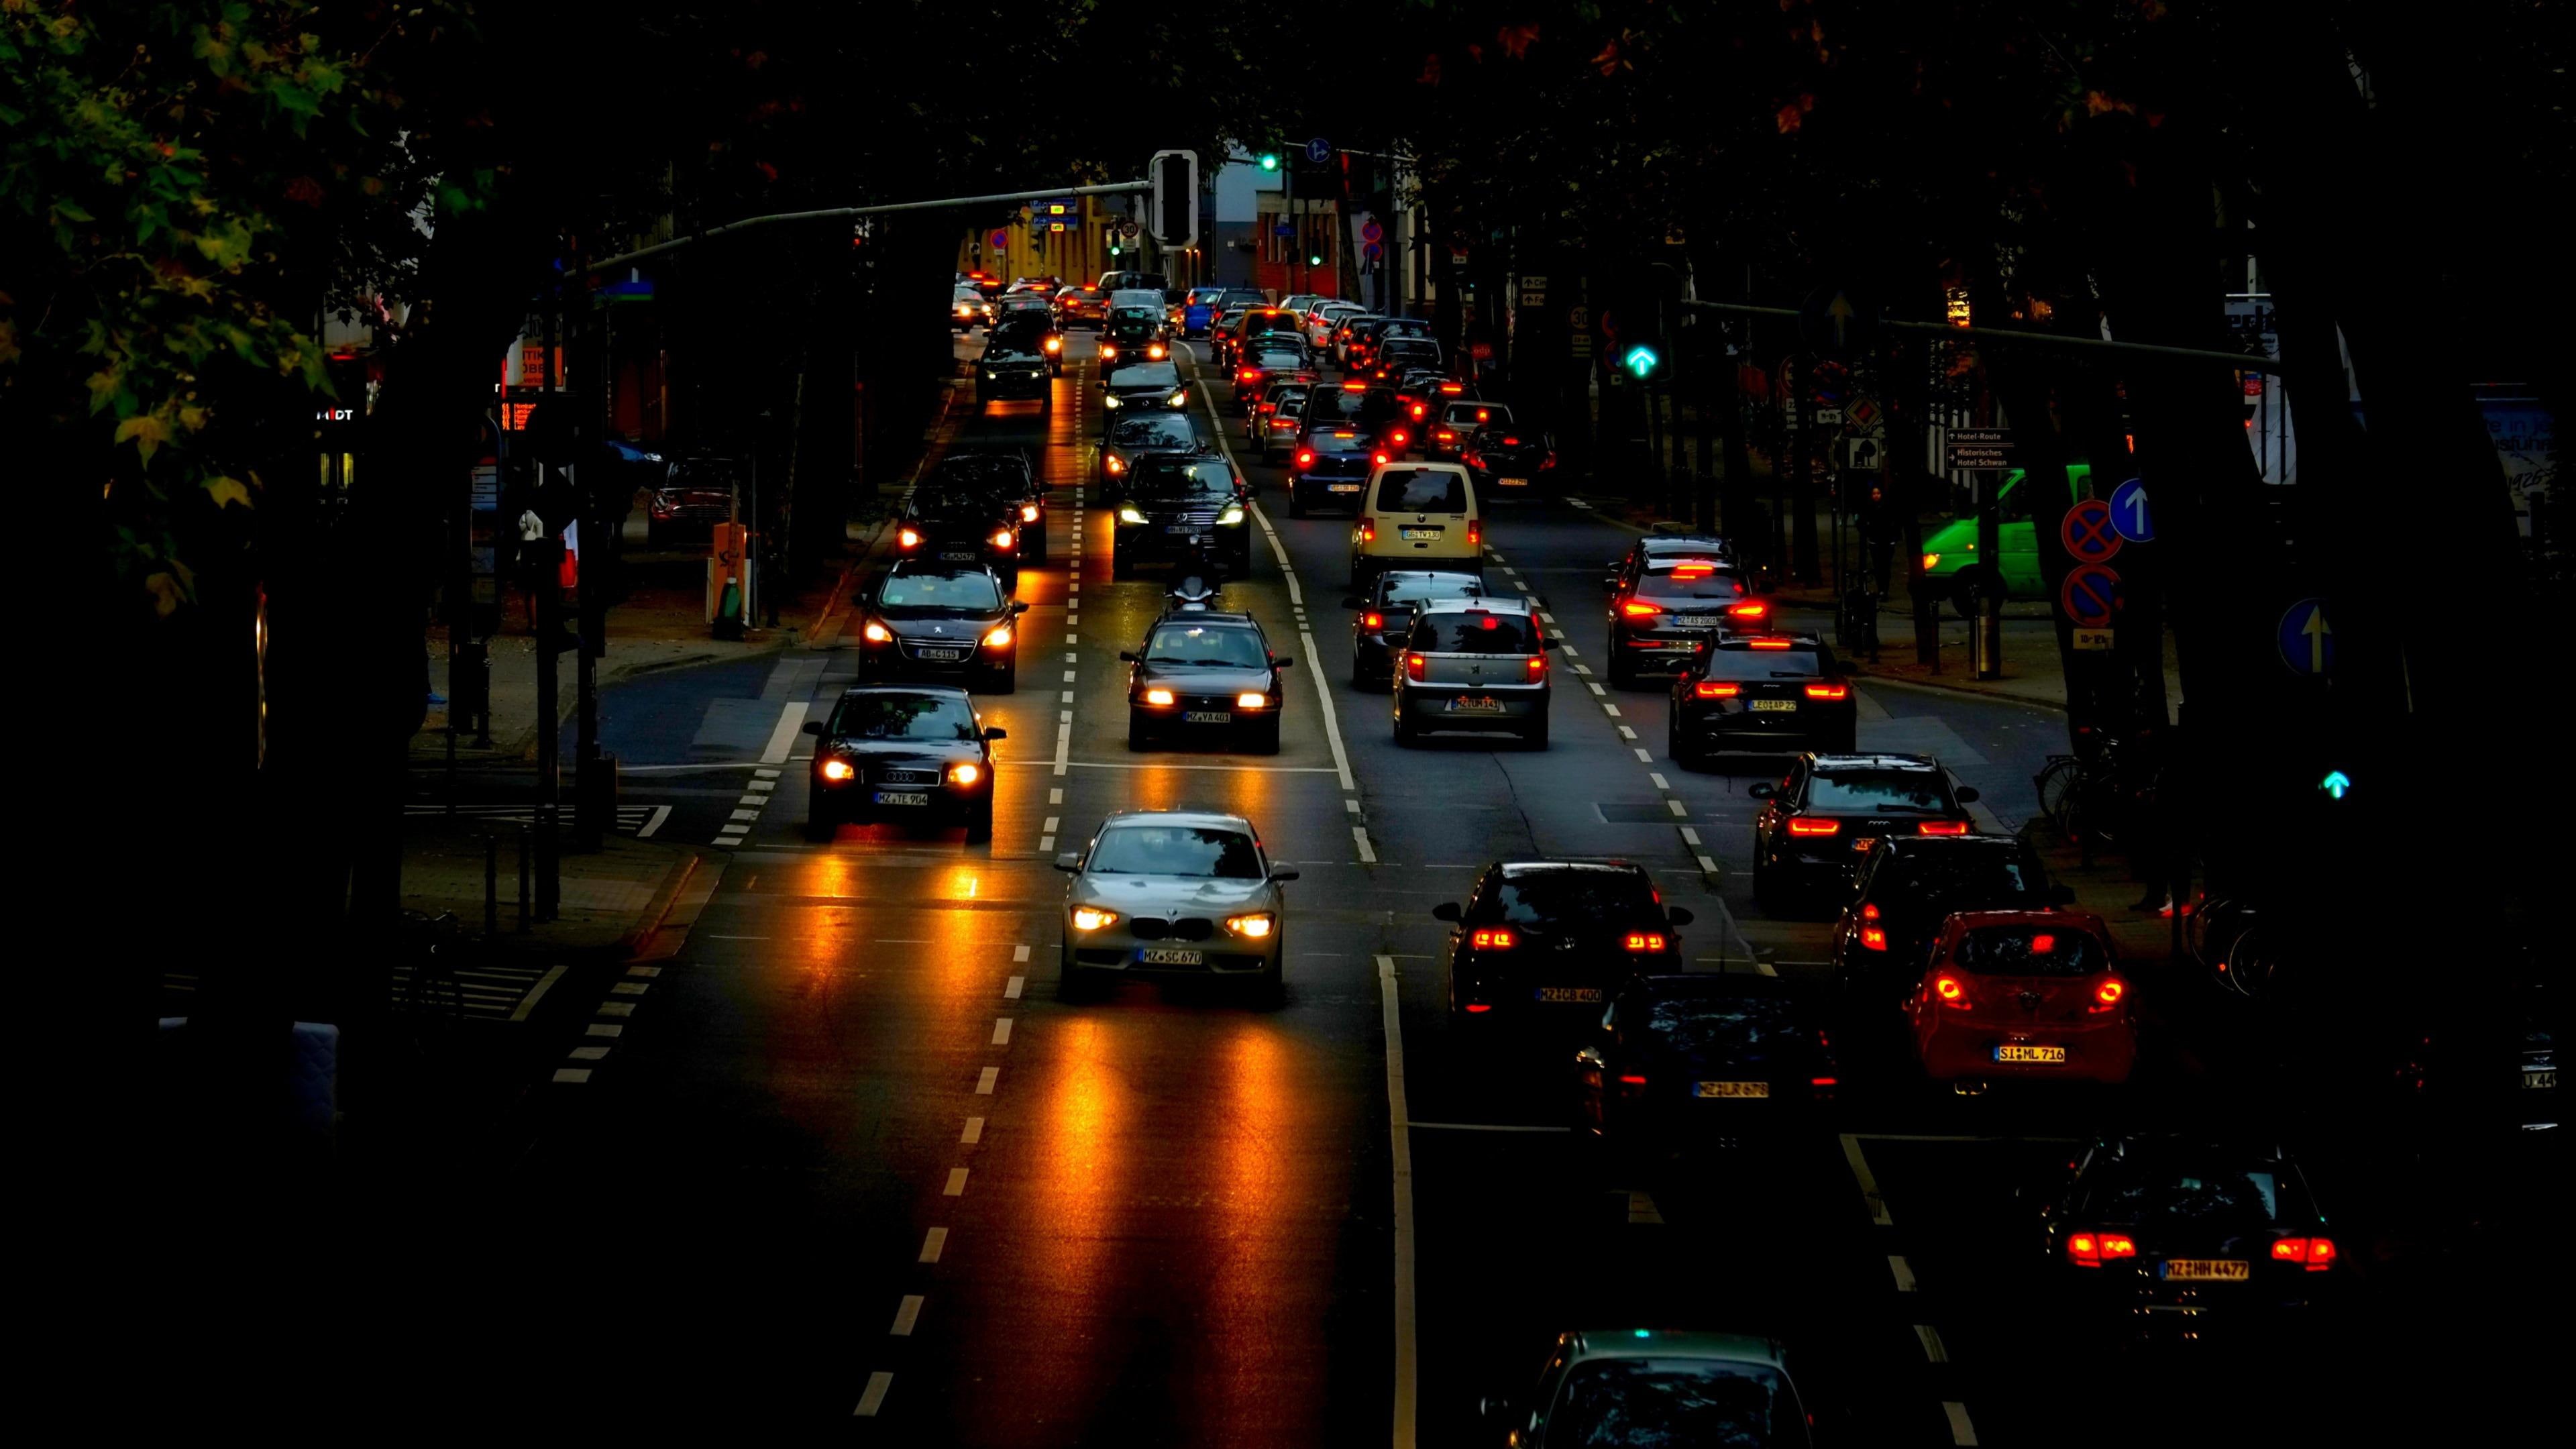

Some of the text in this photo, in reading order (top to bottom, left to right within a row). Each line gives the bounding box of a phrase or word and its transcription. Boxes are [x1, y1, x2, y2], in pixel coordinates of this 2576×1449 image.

[1124, 225, 1134, 234] 30
[1573, 311, 1589, 325] 30
[1957, 432, 2001, 440] Hotel-Route
[1456, 699, 1466, 708] MZ
[1484, 699, 1498, 708] 141
[1752, 700, 1768, 709] LEO
[1786, 700, 1796, 709] 22
[1187, 712, 1197, 720] MZ
[879, 792, 926, 804] MZ TE 904
[1144, 949, 1201, 963] MZ SC 670
[1540, 989, 1601, 1001] MZ CB 400
[2000, 1048, 2063, 1061] SI ML 716
[2167, 1262, 2185, 1276] MZ
[2214, 1263, 2247, 1277] 4477
